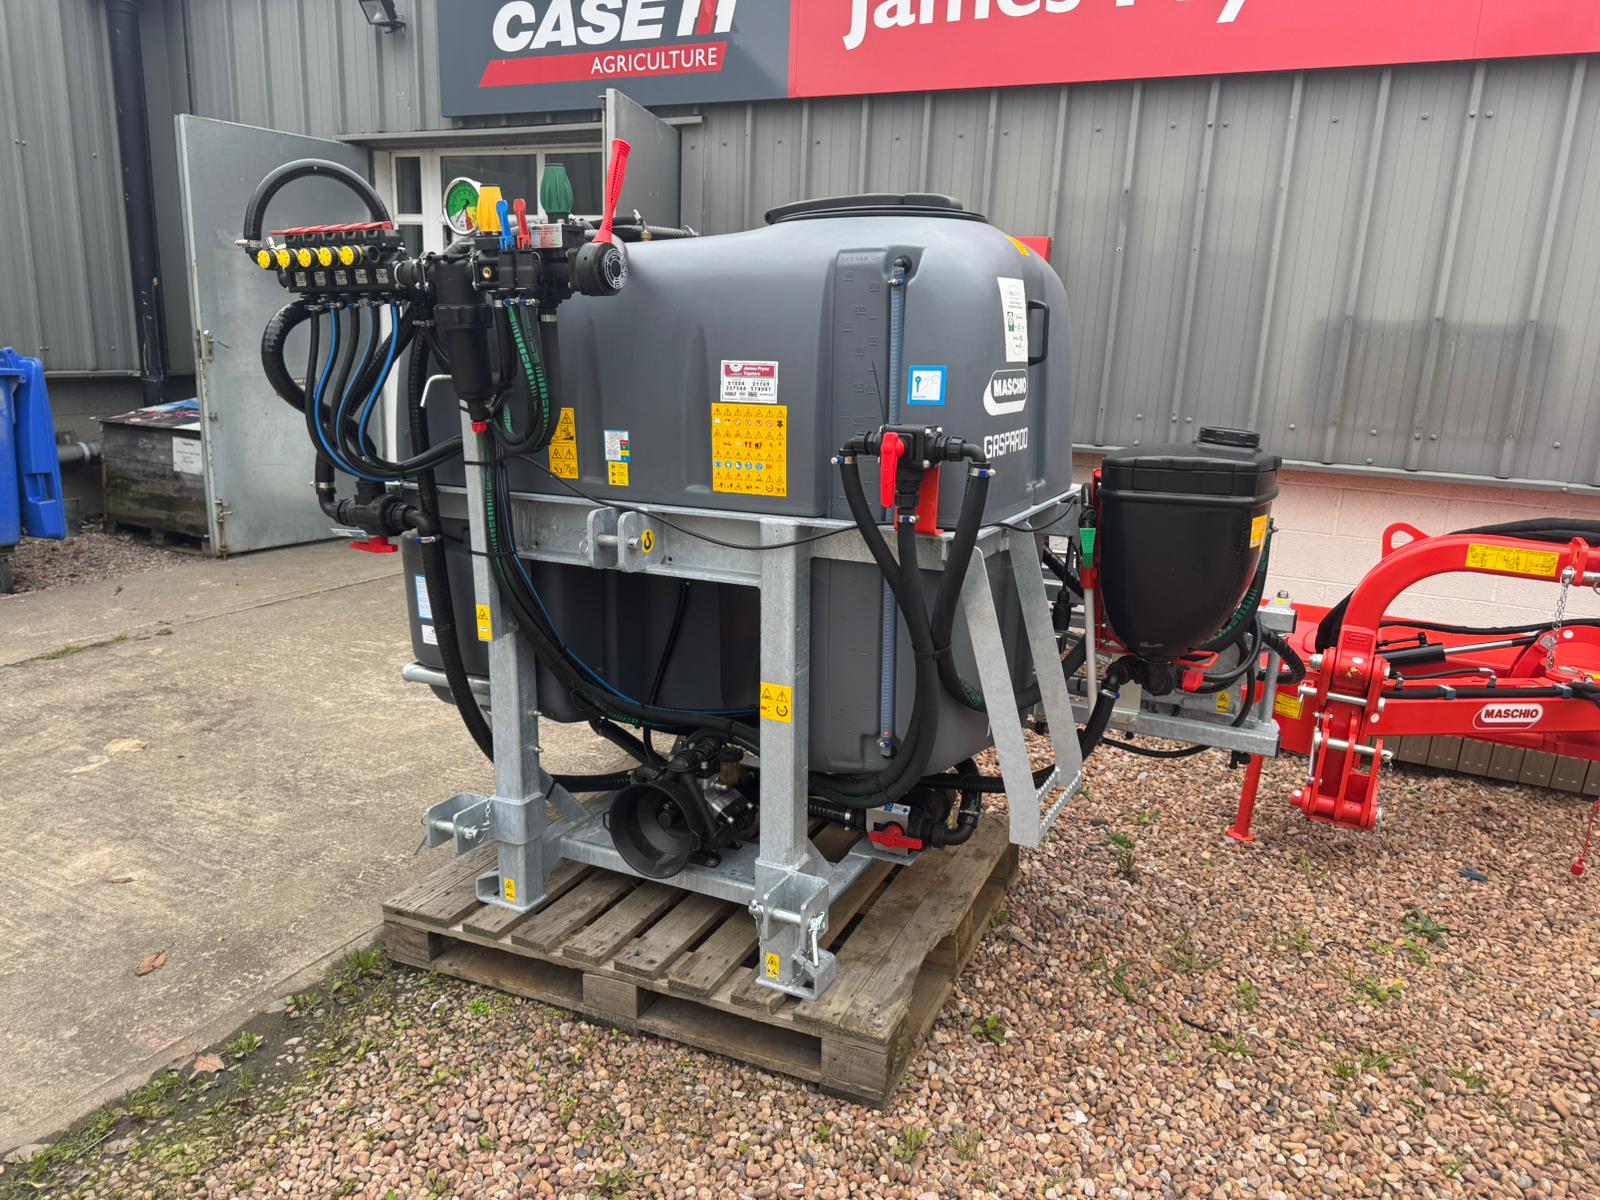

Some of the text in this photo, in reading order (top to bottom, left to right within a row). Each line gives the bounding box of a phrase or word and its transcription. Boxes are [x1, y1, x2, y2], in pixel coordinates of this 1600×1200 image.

[492, 0, 666, 52] CASE
[591, 47, 718, 74] AGRICULTURE
[993, 377, 1027, 397] MASCHIO
[984, 427, 1028, 459] GASPARDO
[1483, 708, 1539, 719] MASCHIO
